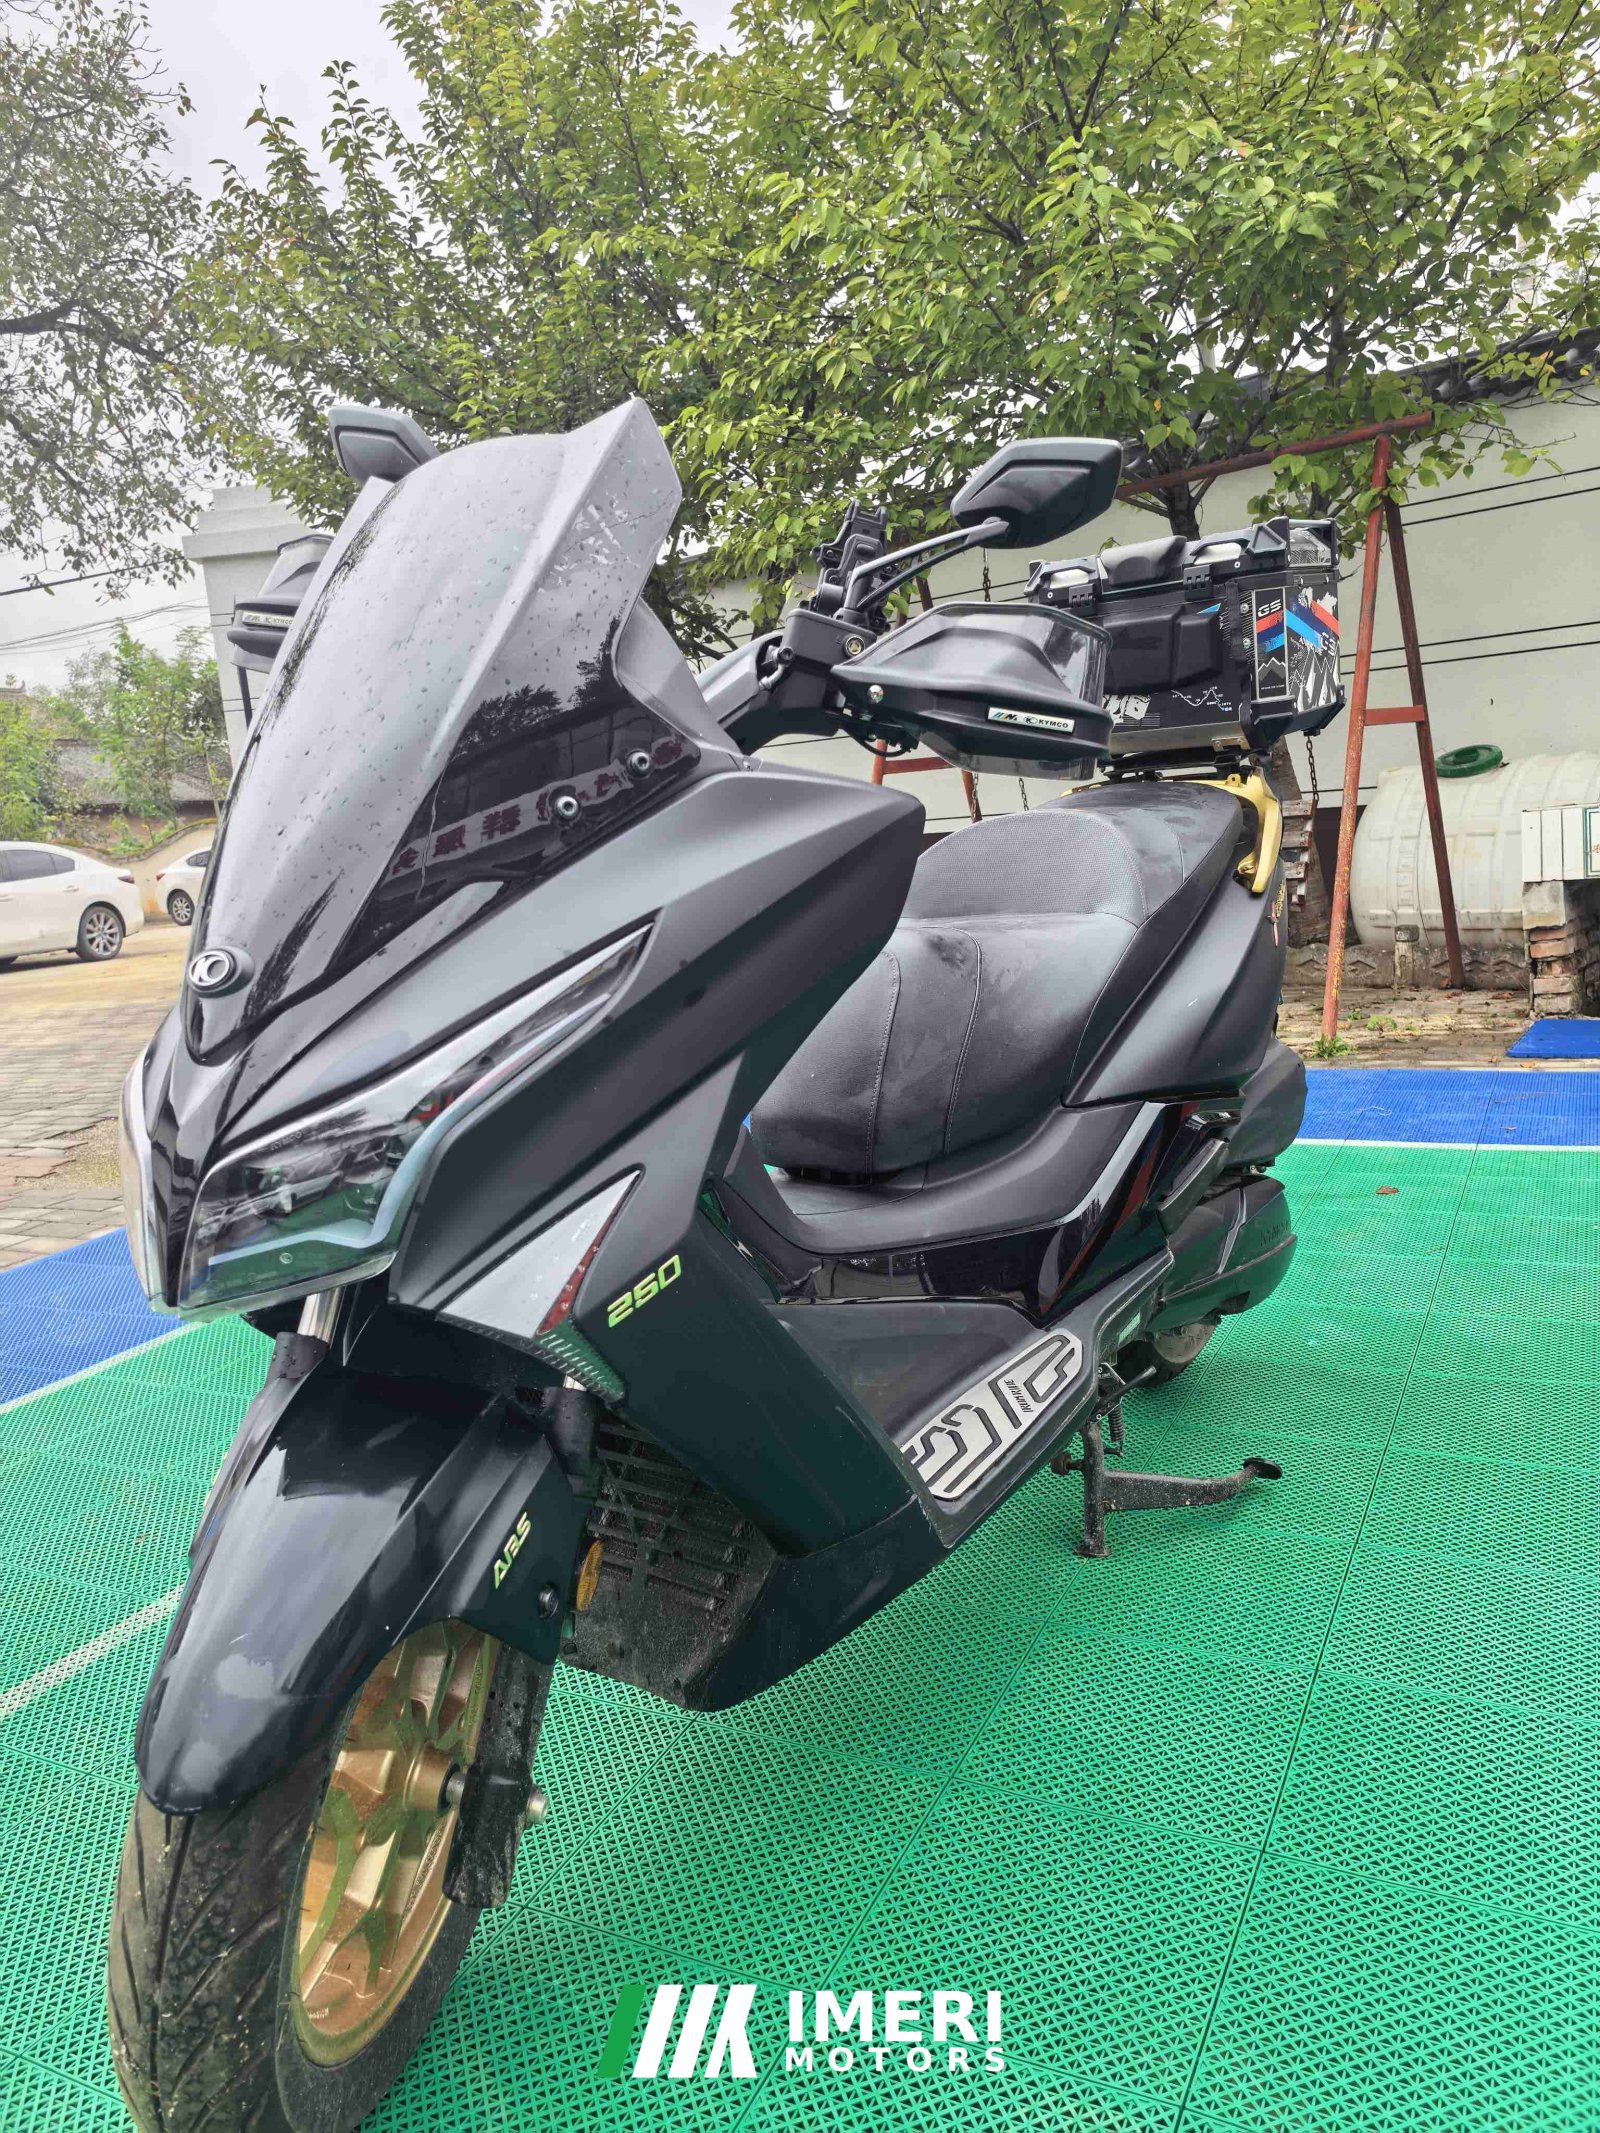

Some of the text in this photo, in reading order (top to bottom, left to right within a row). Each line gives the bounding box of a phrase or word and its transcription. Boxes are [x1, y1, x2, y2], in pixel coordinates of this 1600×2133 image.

[1258, 599, 1282, 617] GS
[1038, 719, 1069, 729] KYMCO
[607, 1254, 682, 1328] 250
[493, 1511, 531, 1590] ABS
